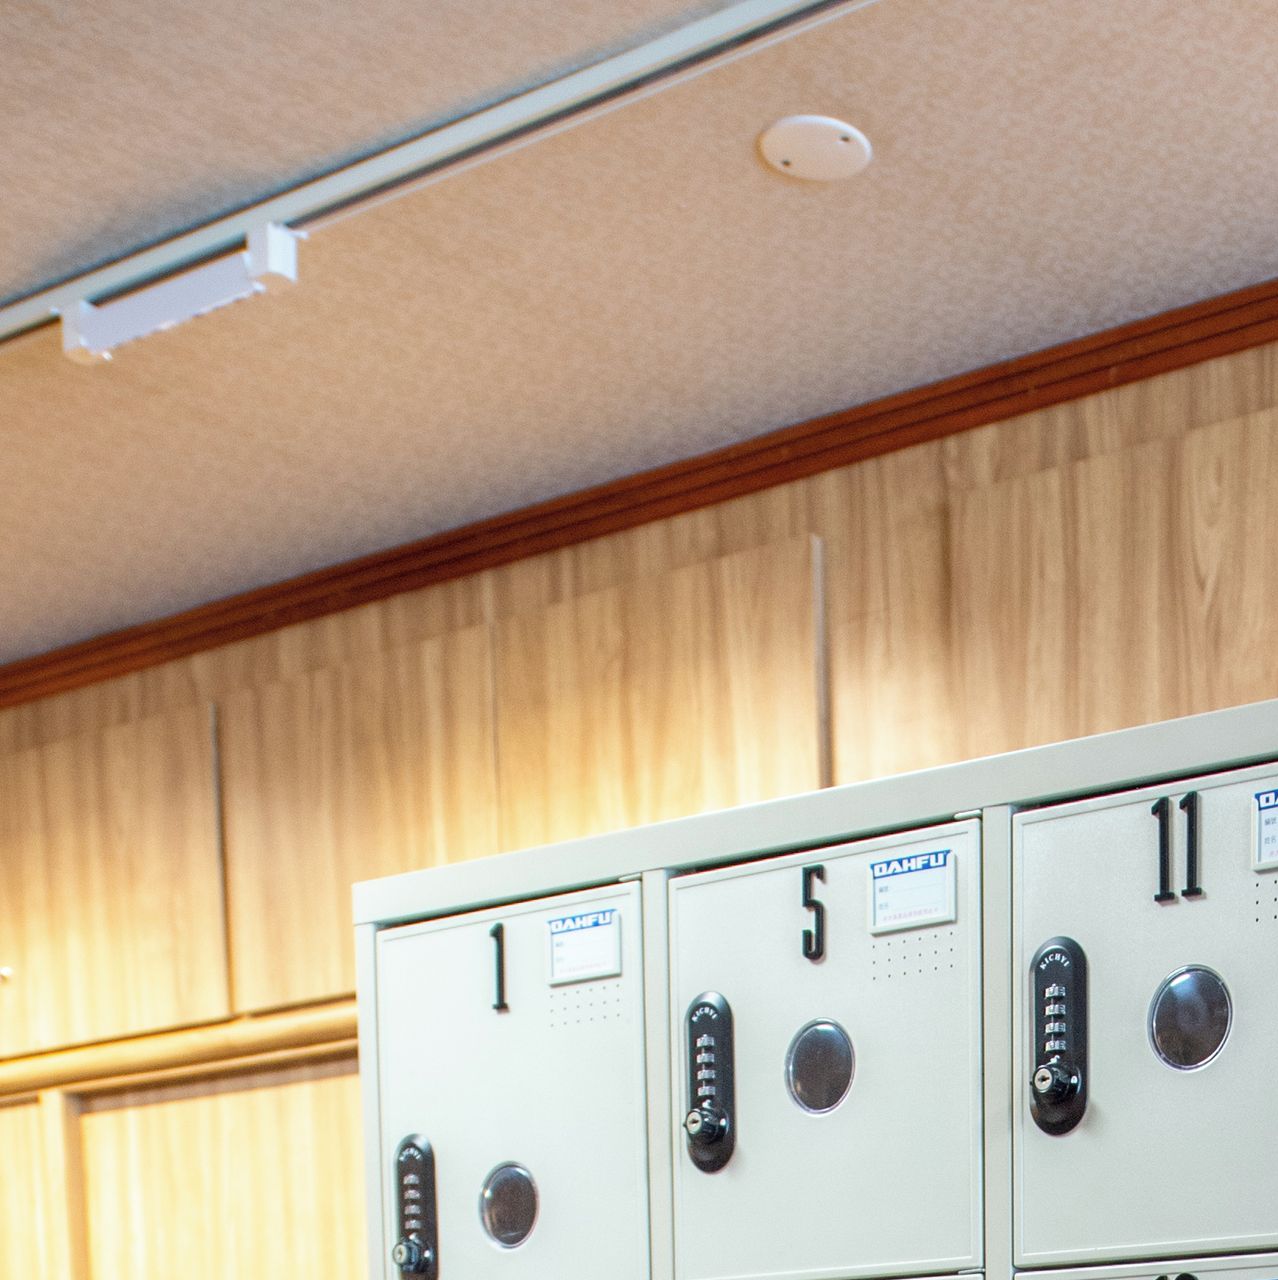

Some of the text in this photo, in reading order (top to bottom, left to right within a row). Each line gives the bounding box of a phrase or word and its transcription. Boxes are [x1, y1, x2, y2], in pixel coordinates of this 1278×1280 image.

[1152, 791, 1202, 902] 11
[874, 854, 945, 877] DAHFU
[552, 912, 610, 932] DAHFU
[803, 866, 824, 960] 5
[492, 925, 507, 1010] 1
[1040, 953, 1069, 970] KICHYI
[692, 1007, 718, 1022] KICHYI
